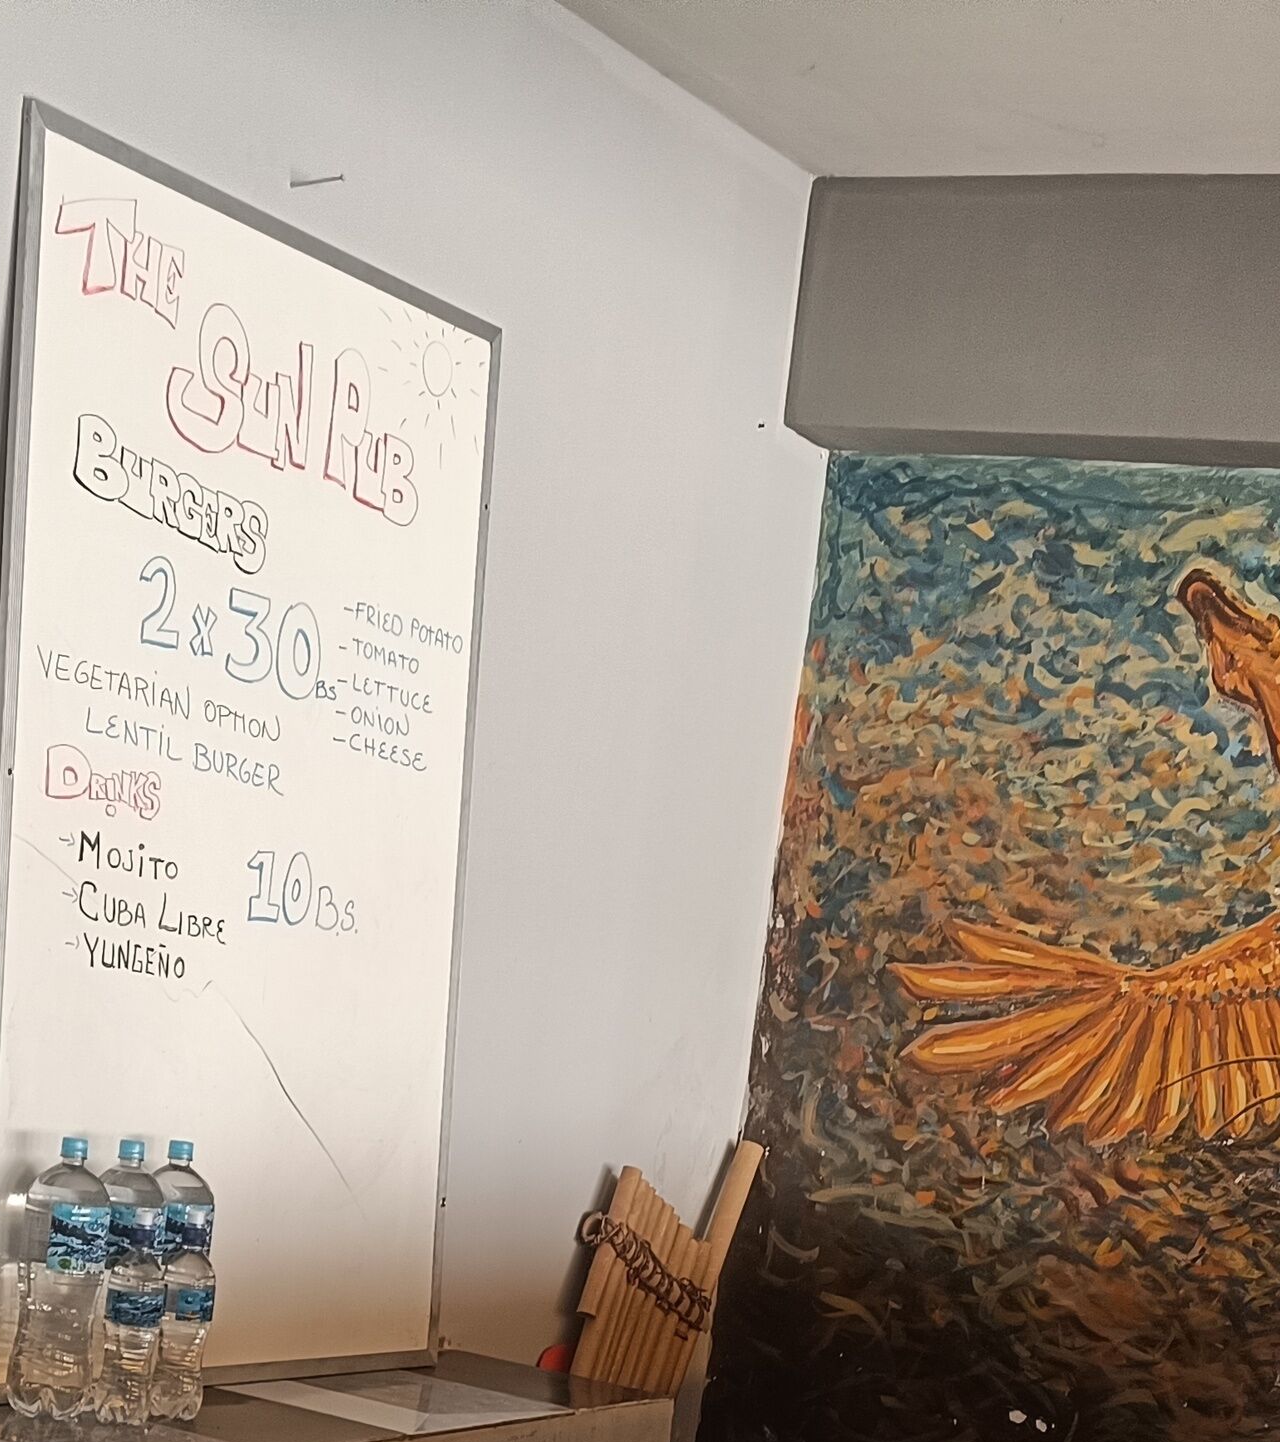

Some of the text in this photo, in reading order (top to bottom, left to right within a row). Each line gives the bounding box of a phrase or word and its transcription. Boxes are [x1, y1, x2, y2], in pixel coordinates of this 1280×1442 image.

[55, 195, 184, 329] THE
[166, 303, 419, 527] SUN PUB
[73, 413, 269, 575] BURGERS
[411, 618, 464, 654] POTATO
[36, 644, 282, 743] VEGETARIAN OPTION
[85, 707, 284, 796] LENTIL BURGER
[78, 880, 227, 945] CUBA LIBRE
[247, 850, 313, 926] 10
